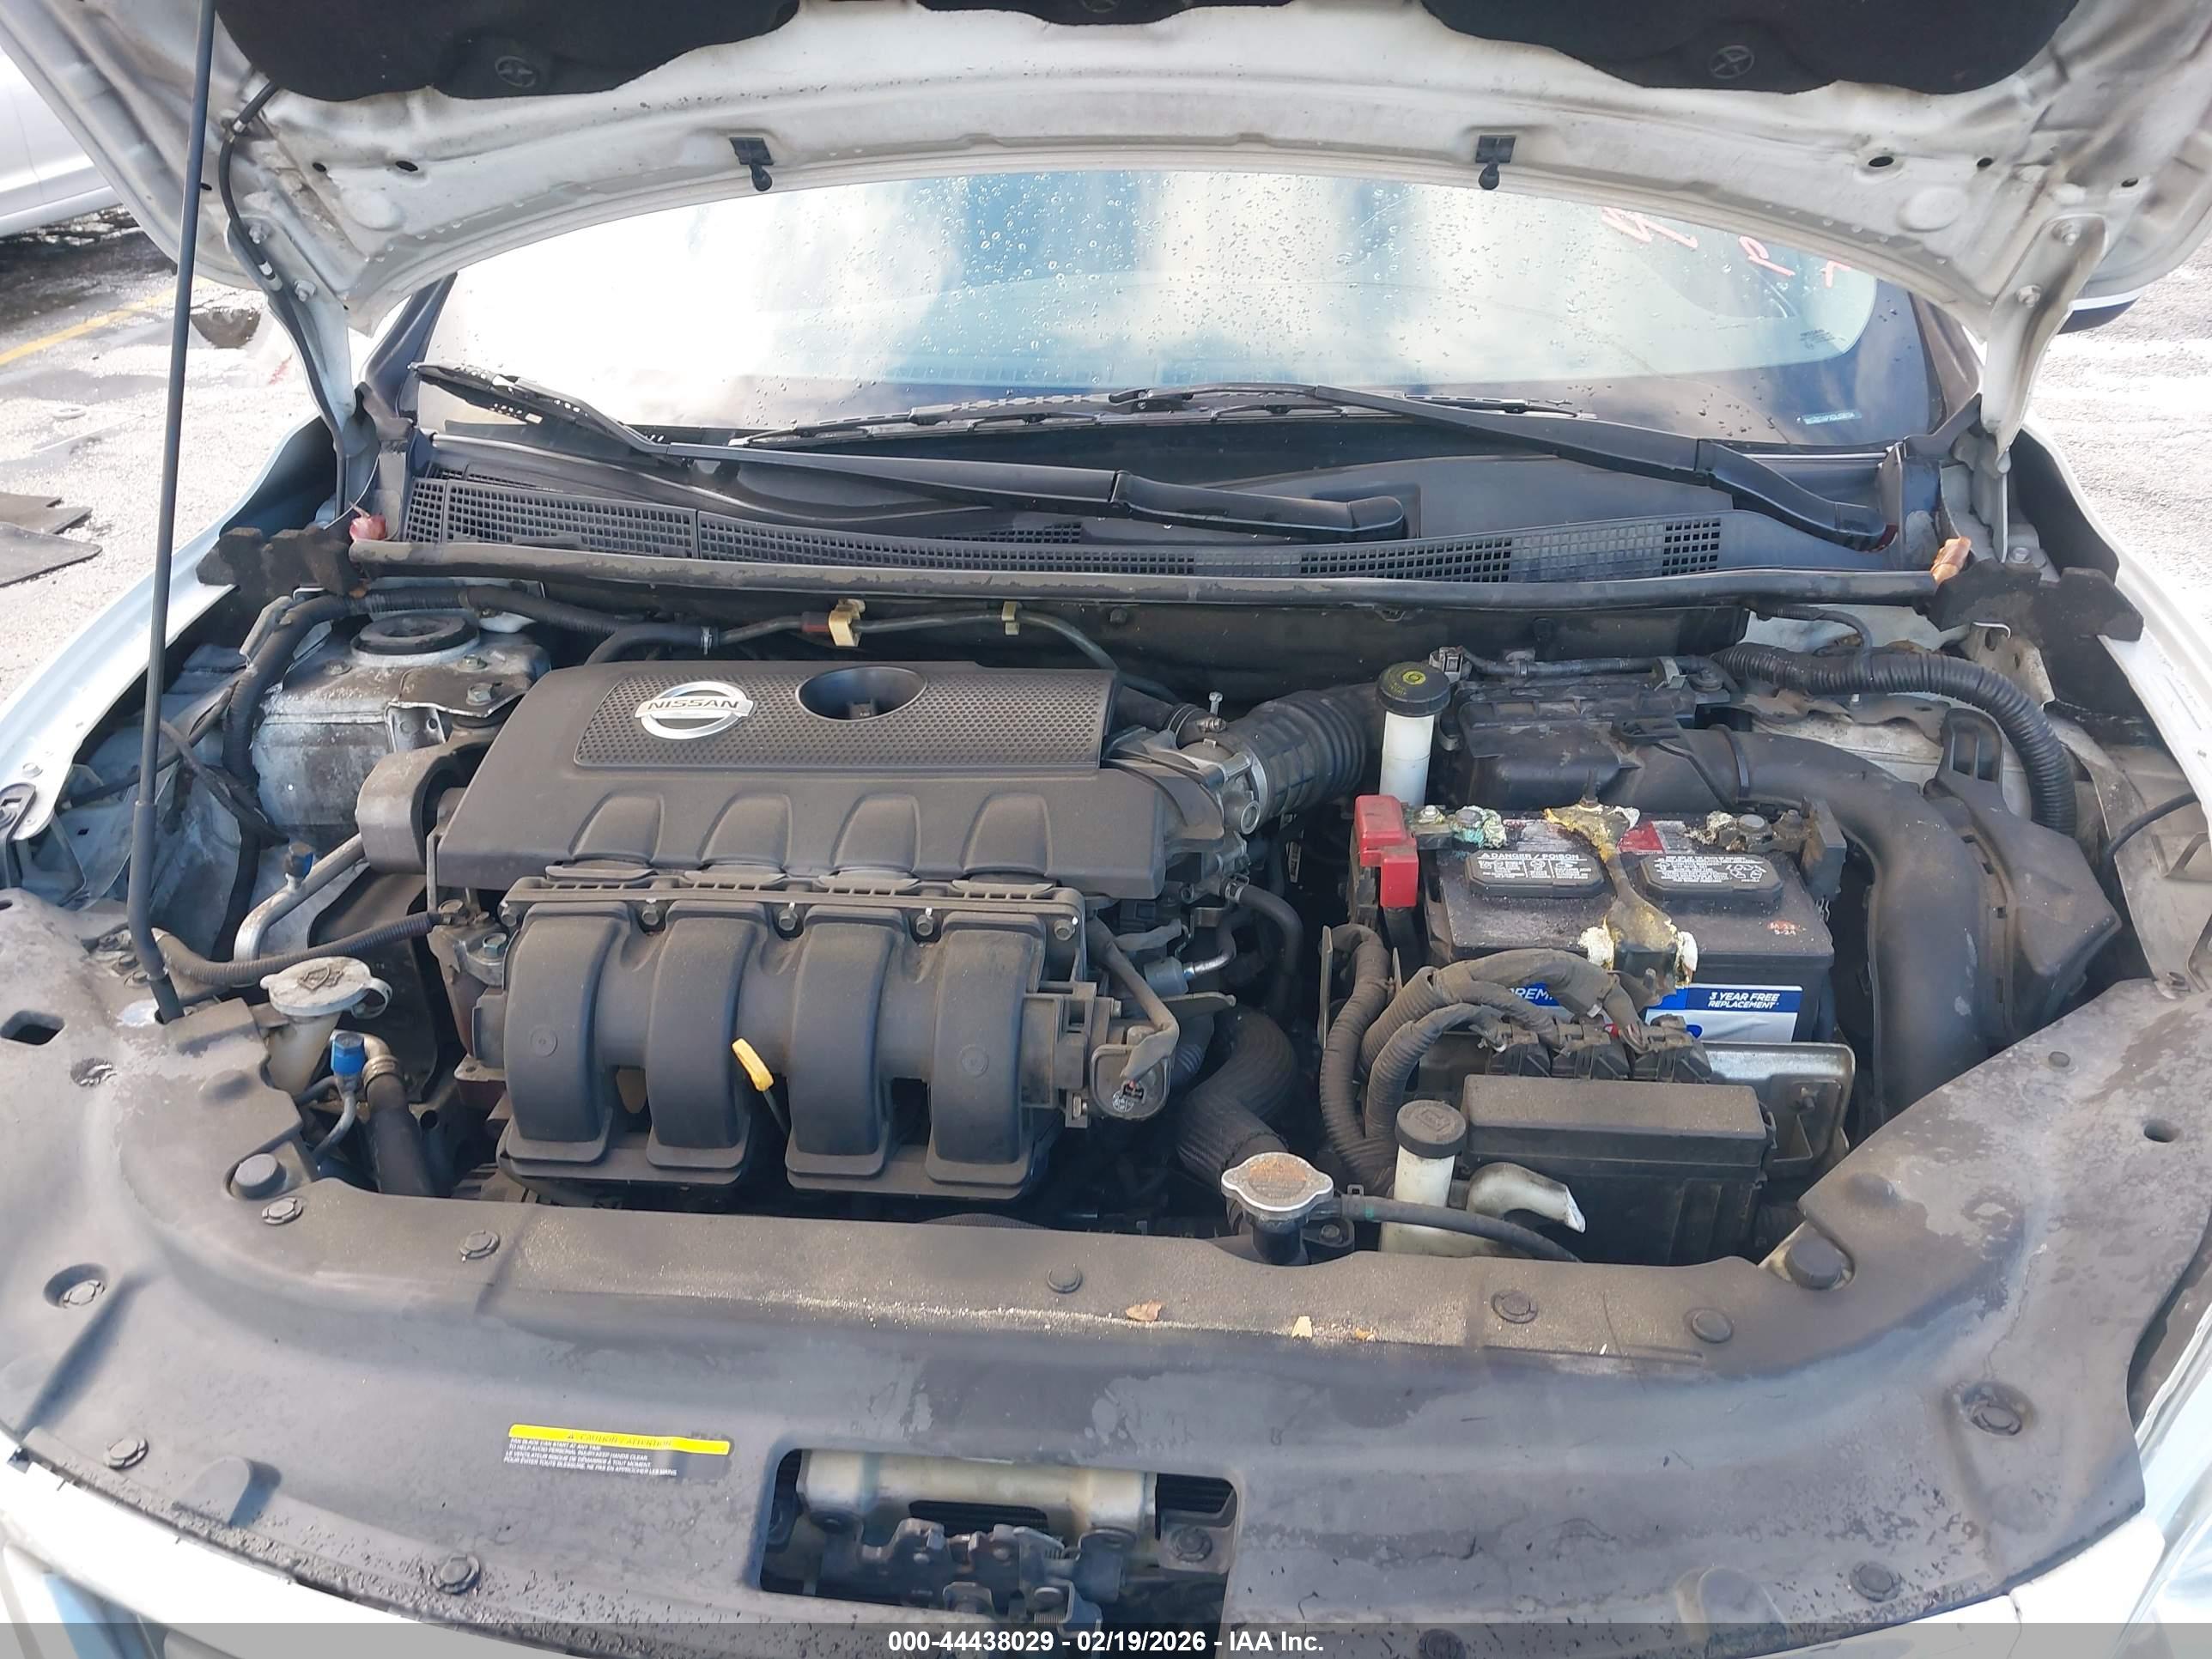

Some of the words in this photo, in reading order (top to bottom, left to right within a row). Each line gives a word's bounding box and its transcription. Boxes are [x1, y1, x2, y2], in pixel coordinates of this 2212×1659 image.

[647, 699, 739, 710] NISSAN
[1709, 992, 1717, 1000] 3
[1719, 992, 1749, 1001] YEAR
[1750, 993, 1780, 1002] FREE
